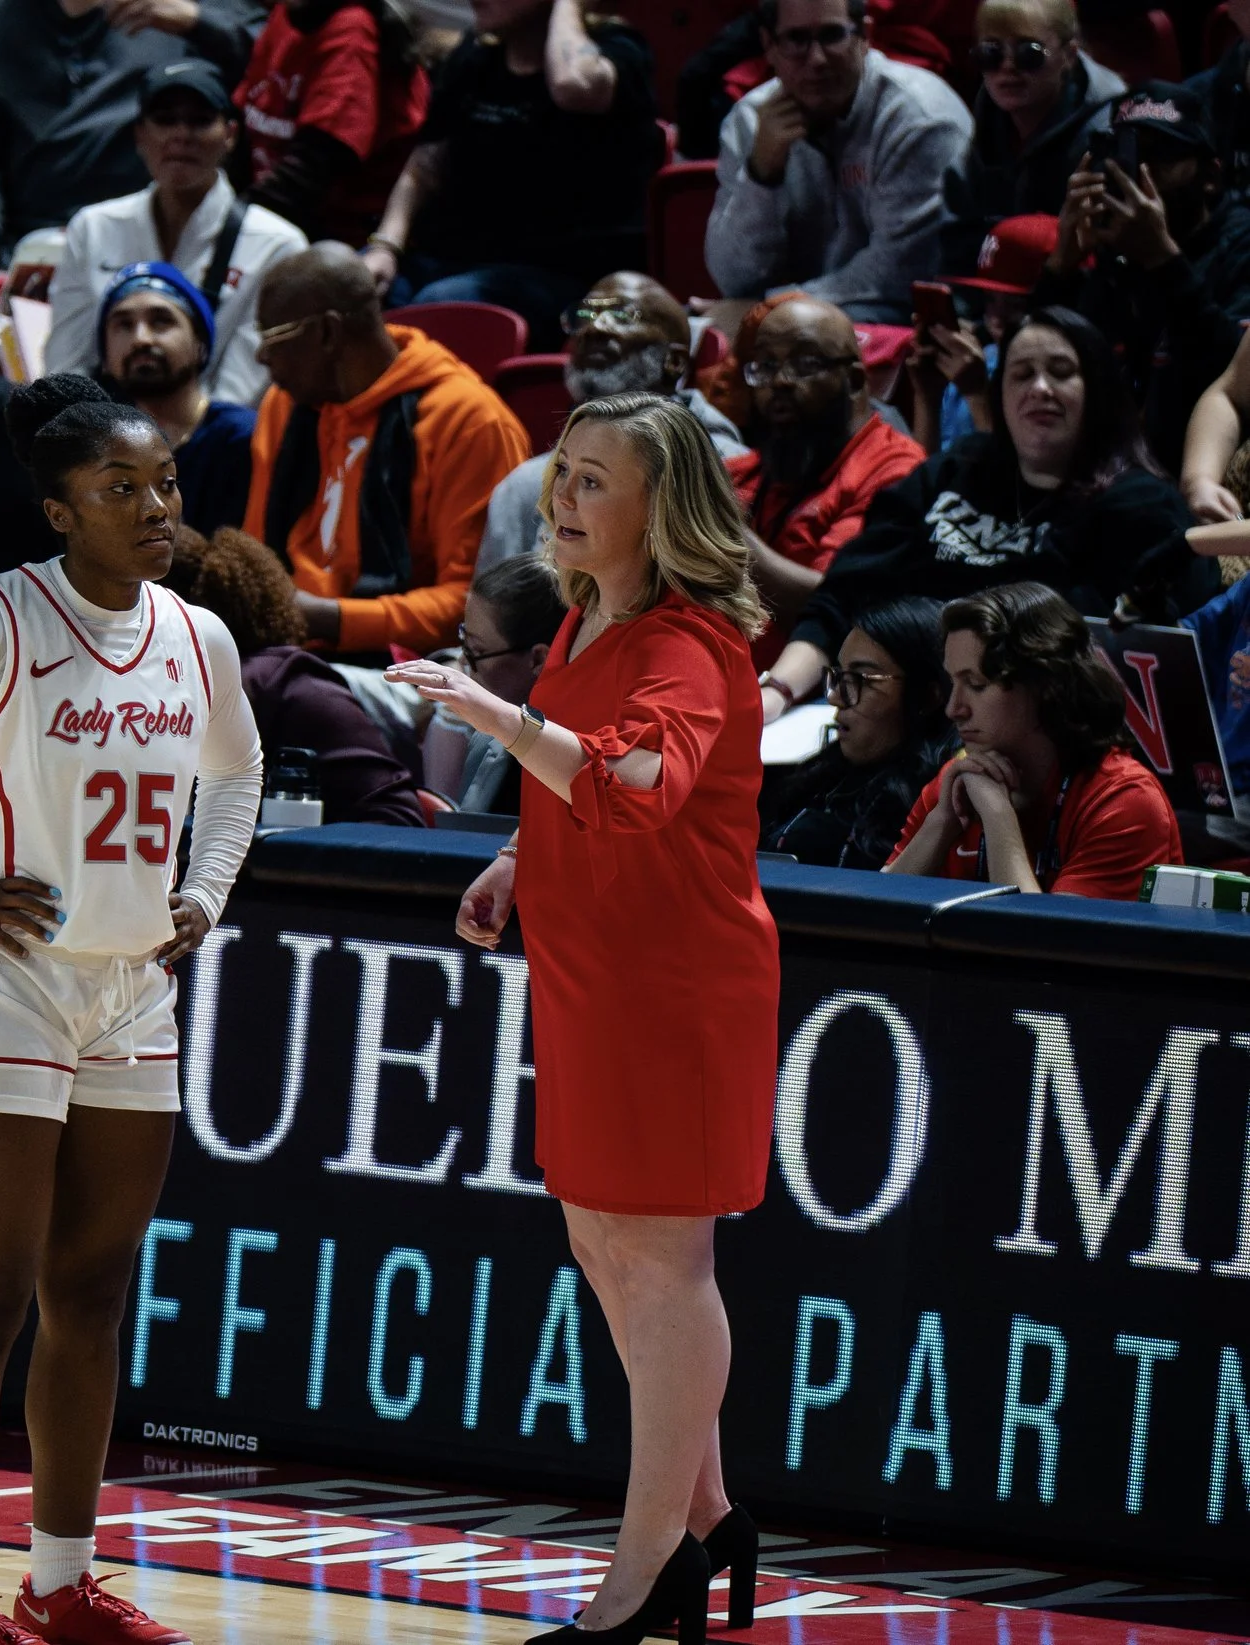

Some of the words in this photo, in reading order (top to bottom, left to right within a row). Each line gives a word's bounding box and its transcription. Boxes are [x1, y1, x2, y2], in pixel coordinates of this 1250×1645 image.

[46, 697, 114, 748] Lady
[116, 699, 194, 748] Rebels
[83, 769, 176, 866] 25
[129, 1217, 588, 1443] FFICIA
[143, 1421, 259, 1453] DAKTRONICS
[24, 1506, 957, 1621] FAMIY
